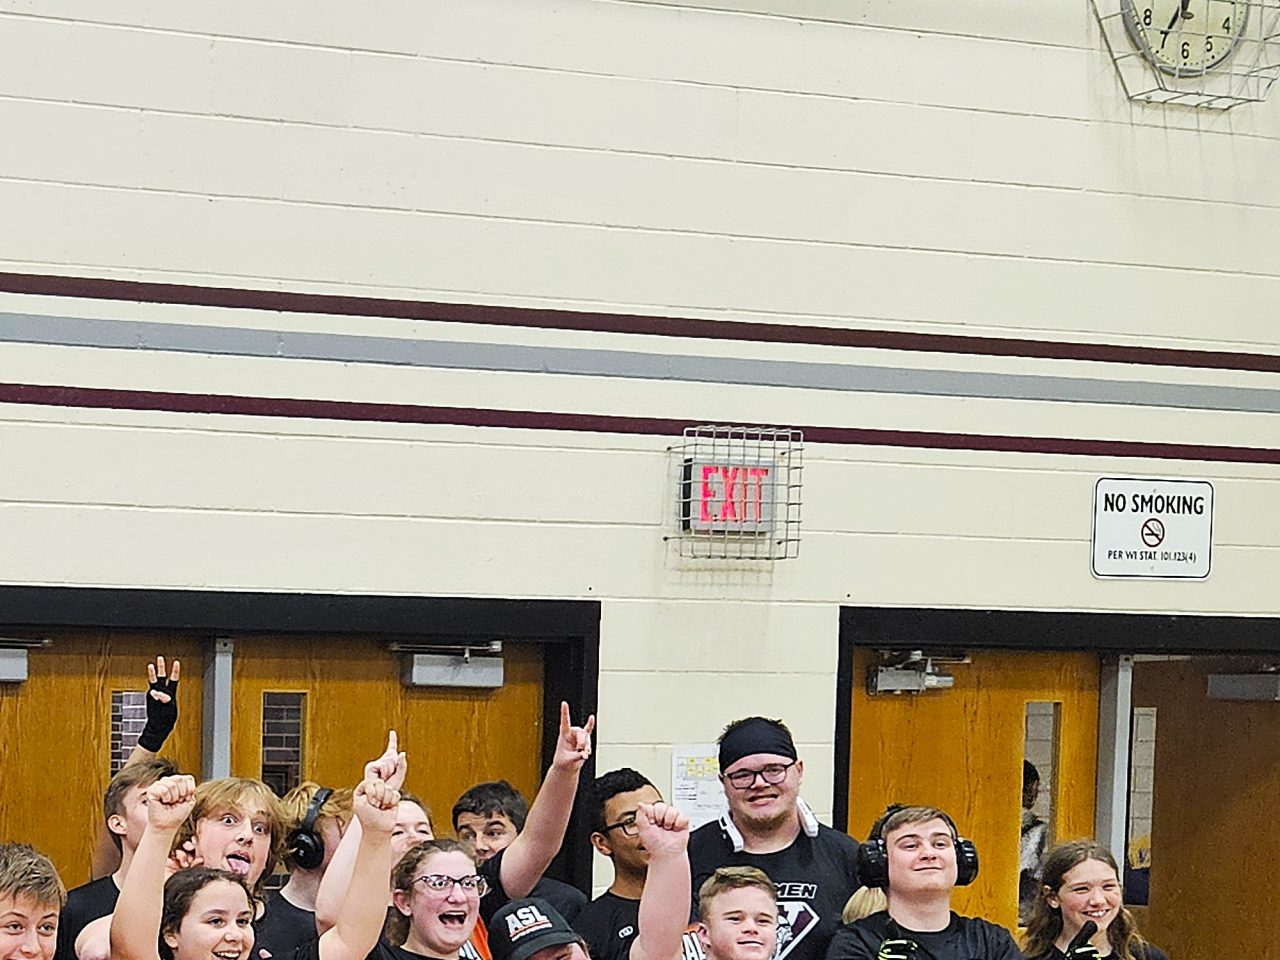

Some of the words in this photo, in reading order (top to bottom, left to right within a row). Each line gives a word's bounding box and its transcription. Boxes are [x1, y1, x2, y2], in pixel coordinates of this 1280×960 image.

[1221, 16, 1231, 34] 4
[1181, 41, 1190, 60] 6
[700, 465, 768, 523] EXIT
[1104, 493, 1126, 513] NO
[1131, 493, 1205, 515] SMOKING
[1108, 550, 1123, 560] PER
[505, 905, 548, 938] ASL
